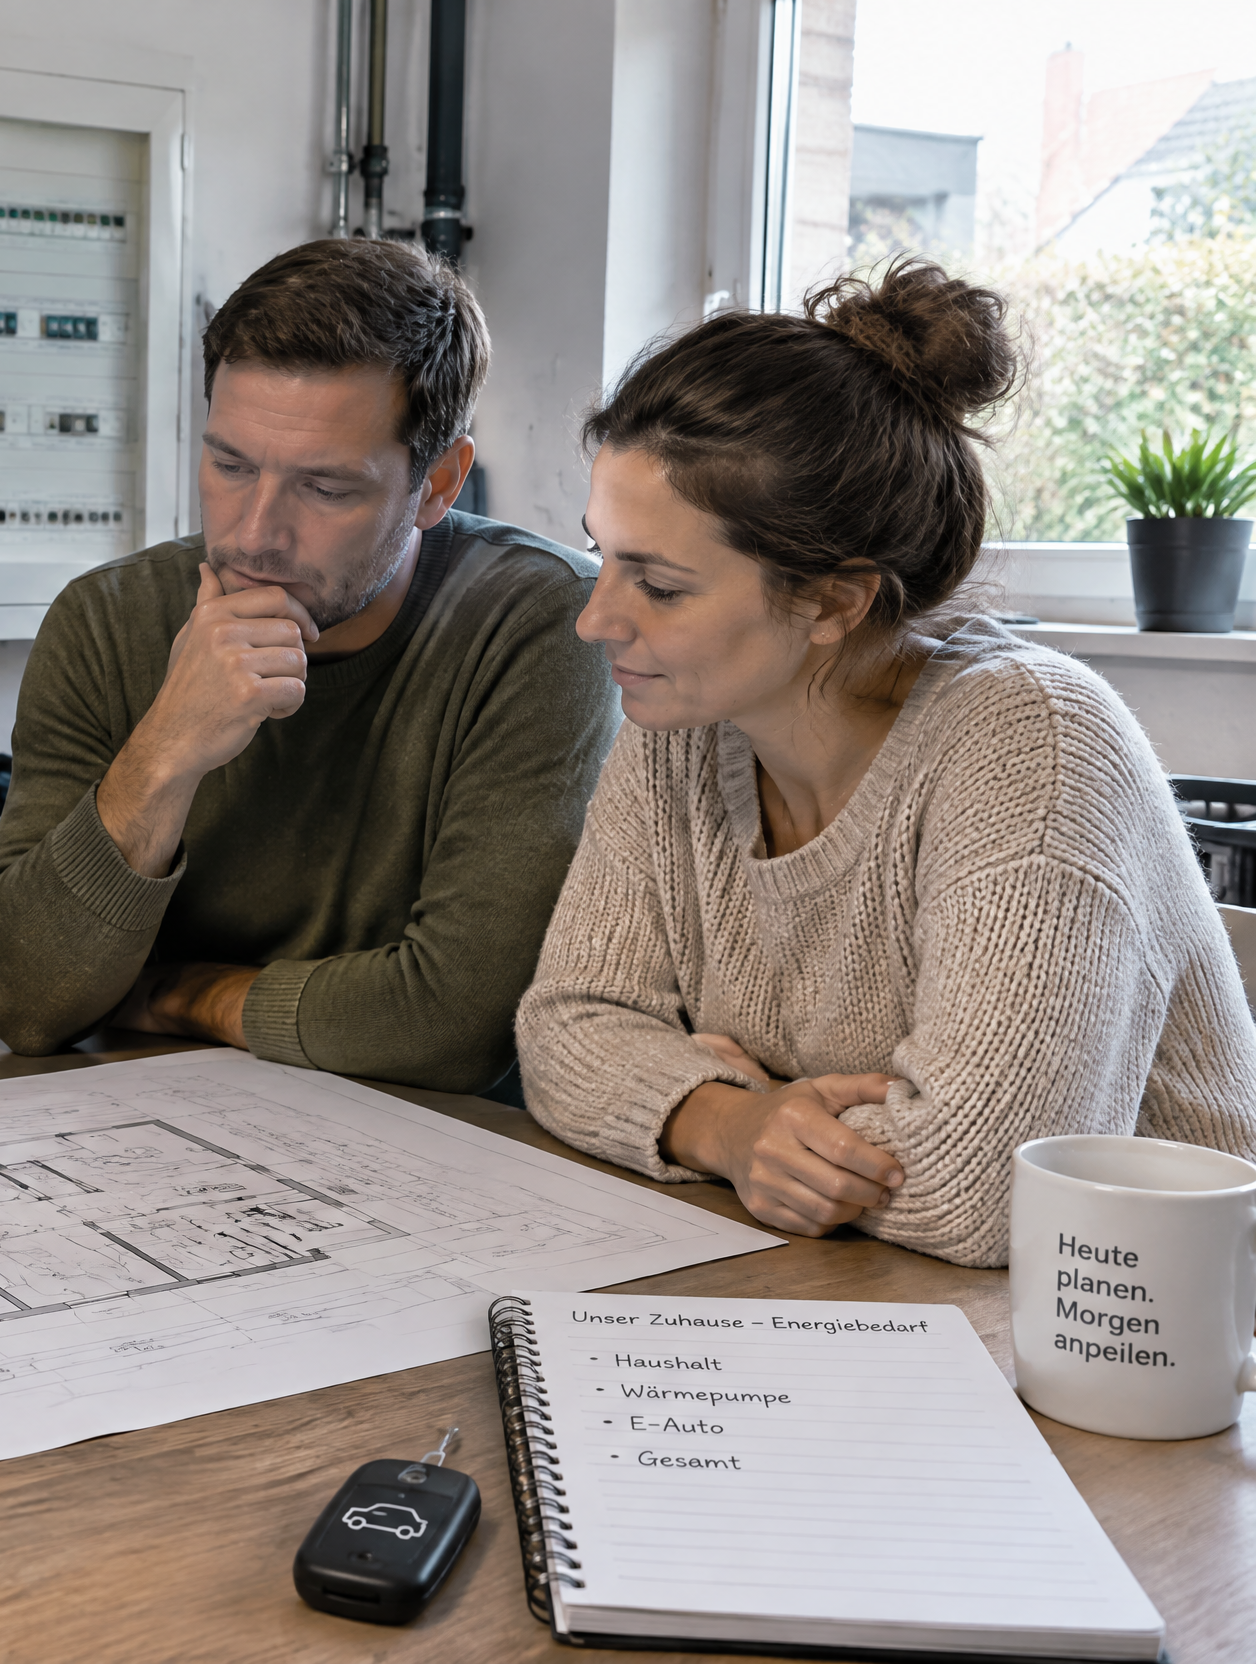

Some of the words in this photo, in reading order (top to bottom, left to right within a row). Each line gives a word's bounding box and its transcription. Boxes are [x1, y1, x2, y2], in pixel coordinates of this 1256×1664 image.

[1059, 1232, 1139, 1268] Heute
[1057, 1268, 1154, 1303] planen.
[572, 1311, 640, 1325] Unser
[649, 1313, 745, 1328] Zuhause
[772, 1316, 928, 1334] Energiebedarf
[1056, 1296, 1160, 1336] Morgen
[1054, 1333, 1176, 1367] anpeilen.
[615, 1354, 723, 1371] Haushalt
[621, 1384, 792, 1408] Wärmepumpe
[630, 1416, 724, 1435] E-Auto
[638, 1451, 742, 1470] Gesamt
